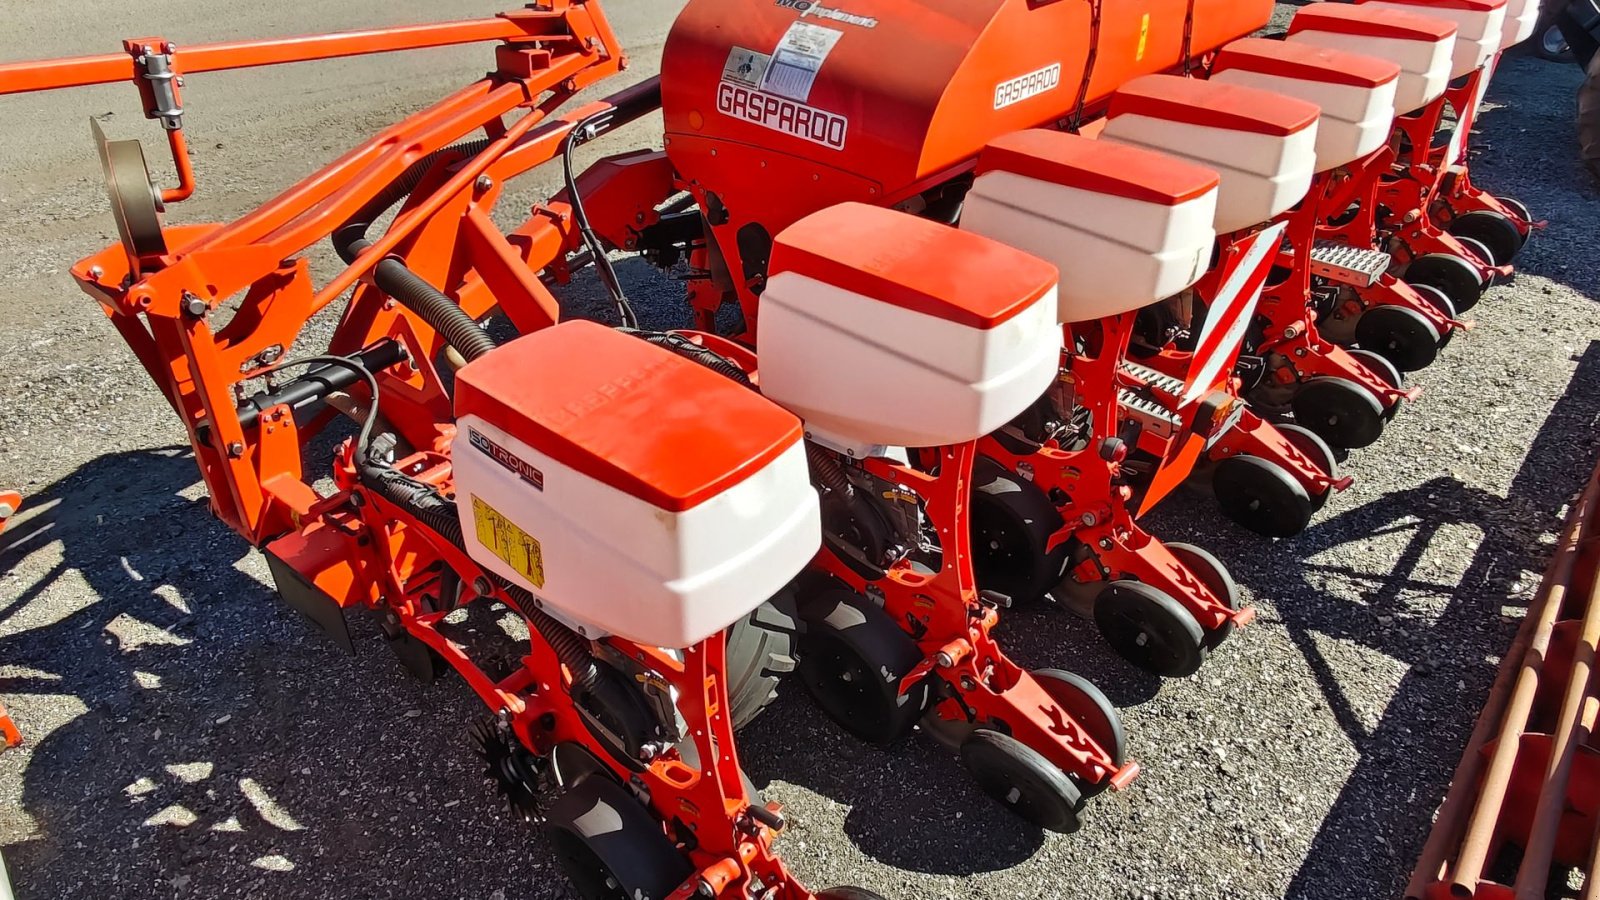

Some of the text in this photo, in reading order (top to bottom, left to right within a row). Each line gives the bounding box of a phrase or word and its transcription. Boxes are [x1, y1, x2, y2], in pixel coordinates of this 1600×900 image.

[995, 65, 1059, 107] GASPARDO
[718, 83, 845, 147] GASPARDO
[469, 429, 543, 485] ISOTRONIC
